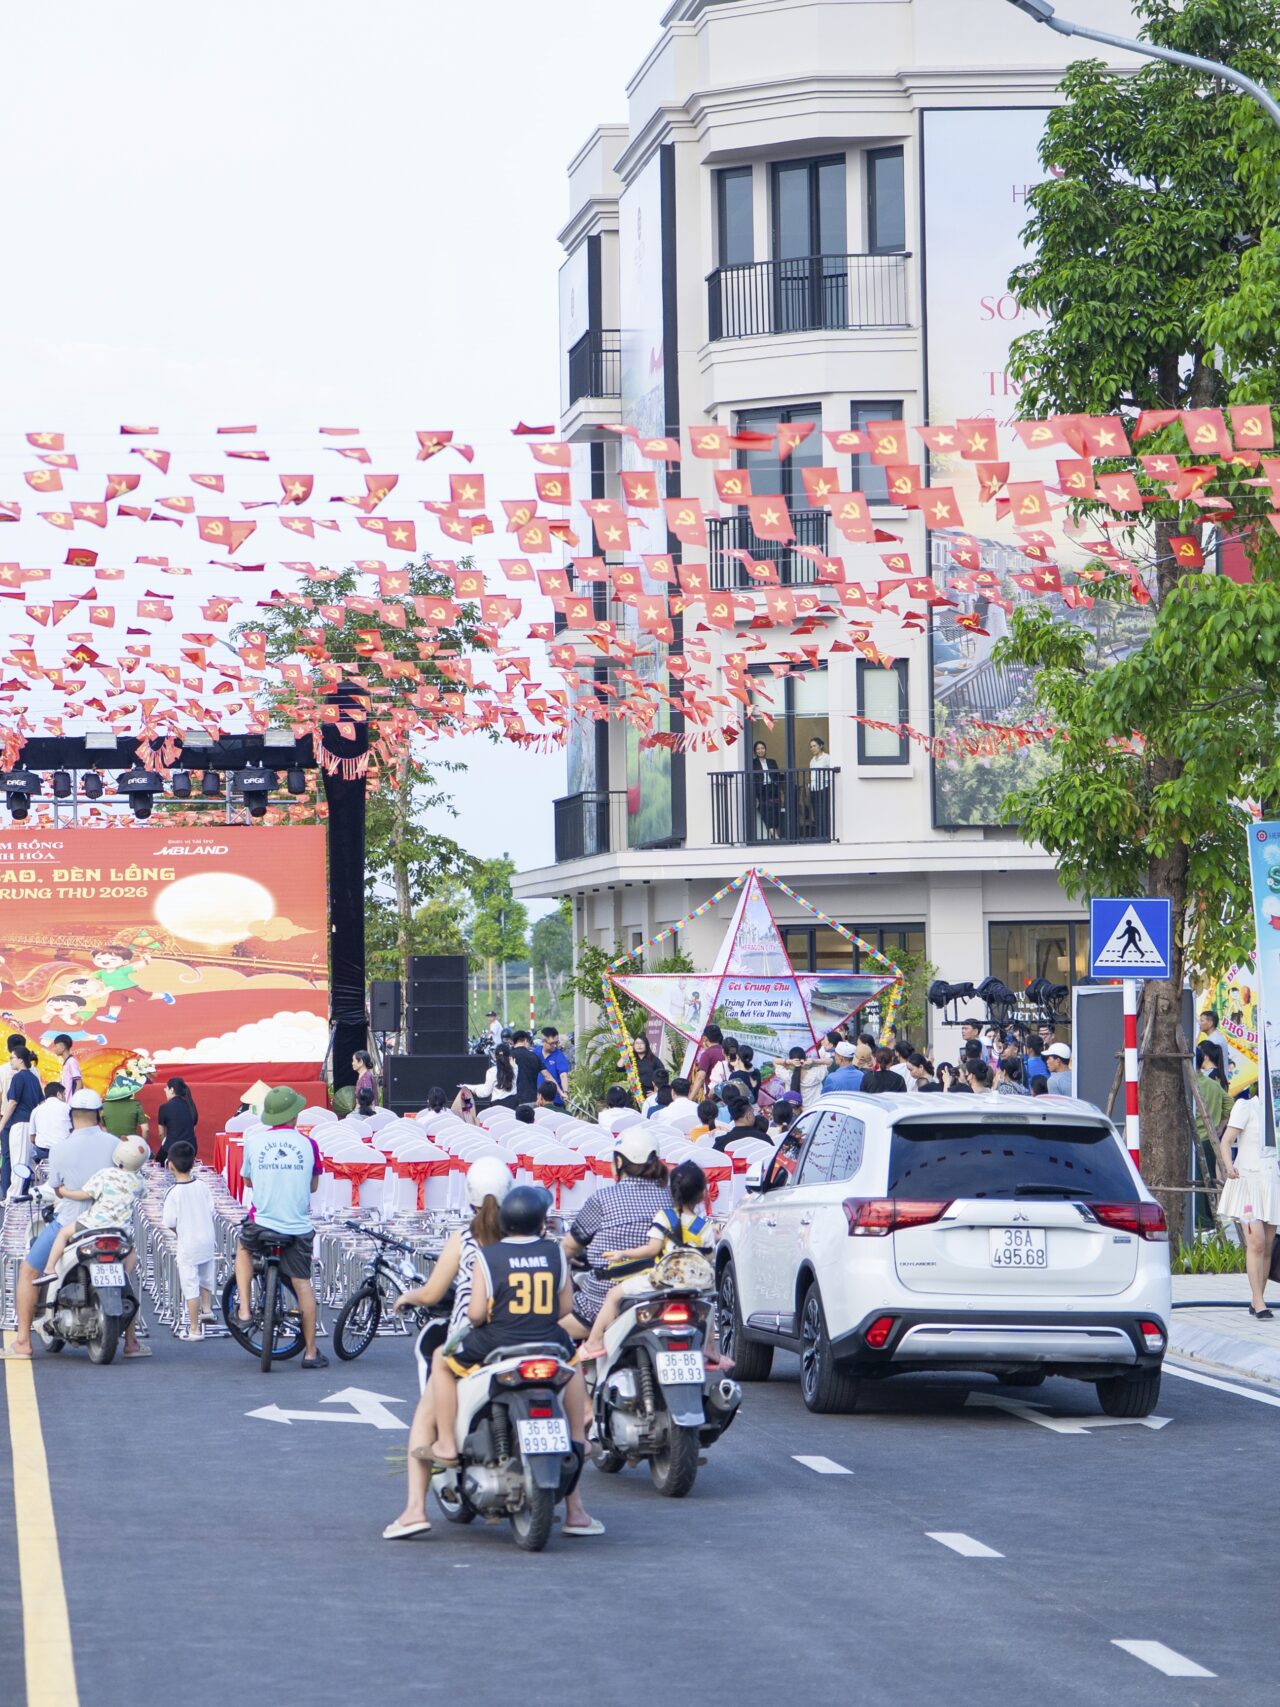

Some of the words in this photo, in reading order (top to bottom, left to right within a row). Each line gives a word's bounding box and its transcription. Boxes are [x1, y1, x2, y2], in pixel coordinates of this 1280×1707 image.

[17, 839, 64, 850] RỒNG
[153, 846, 229, 856] MBLAND
[19, 850, 56, 860] HÓA
[52, 866, 101, 882] ĐÈN
[110, 864, 176, 882] LỒNG
[56, 886, 96, 899] THU
[99, 886, 148, 899] 2026
[744, 982, 771, 993] Trung
[773, 982, 790, 991] Thu
[1032, 1011, 1049, 1020] NA
[1004, 1229, 1033, 1247] 36A
[509, 1256, 549, 1268] NAME
[993, 1248, 1045, 1266] 495.68
[95, 1265, 119, 1275] 36-B4
[94, 1276, 123, 1285] 625.16
[508, 1271, 554, 1315] 30
[664, 1353, 697, 1367] 36-B6
[662, 1367, 703, 1381] 838.93
[527, 1421, 561, 1435] 36-B8
[524, 1436, 568, 1452] 899.25
